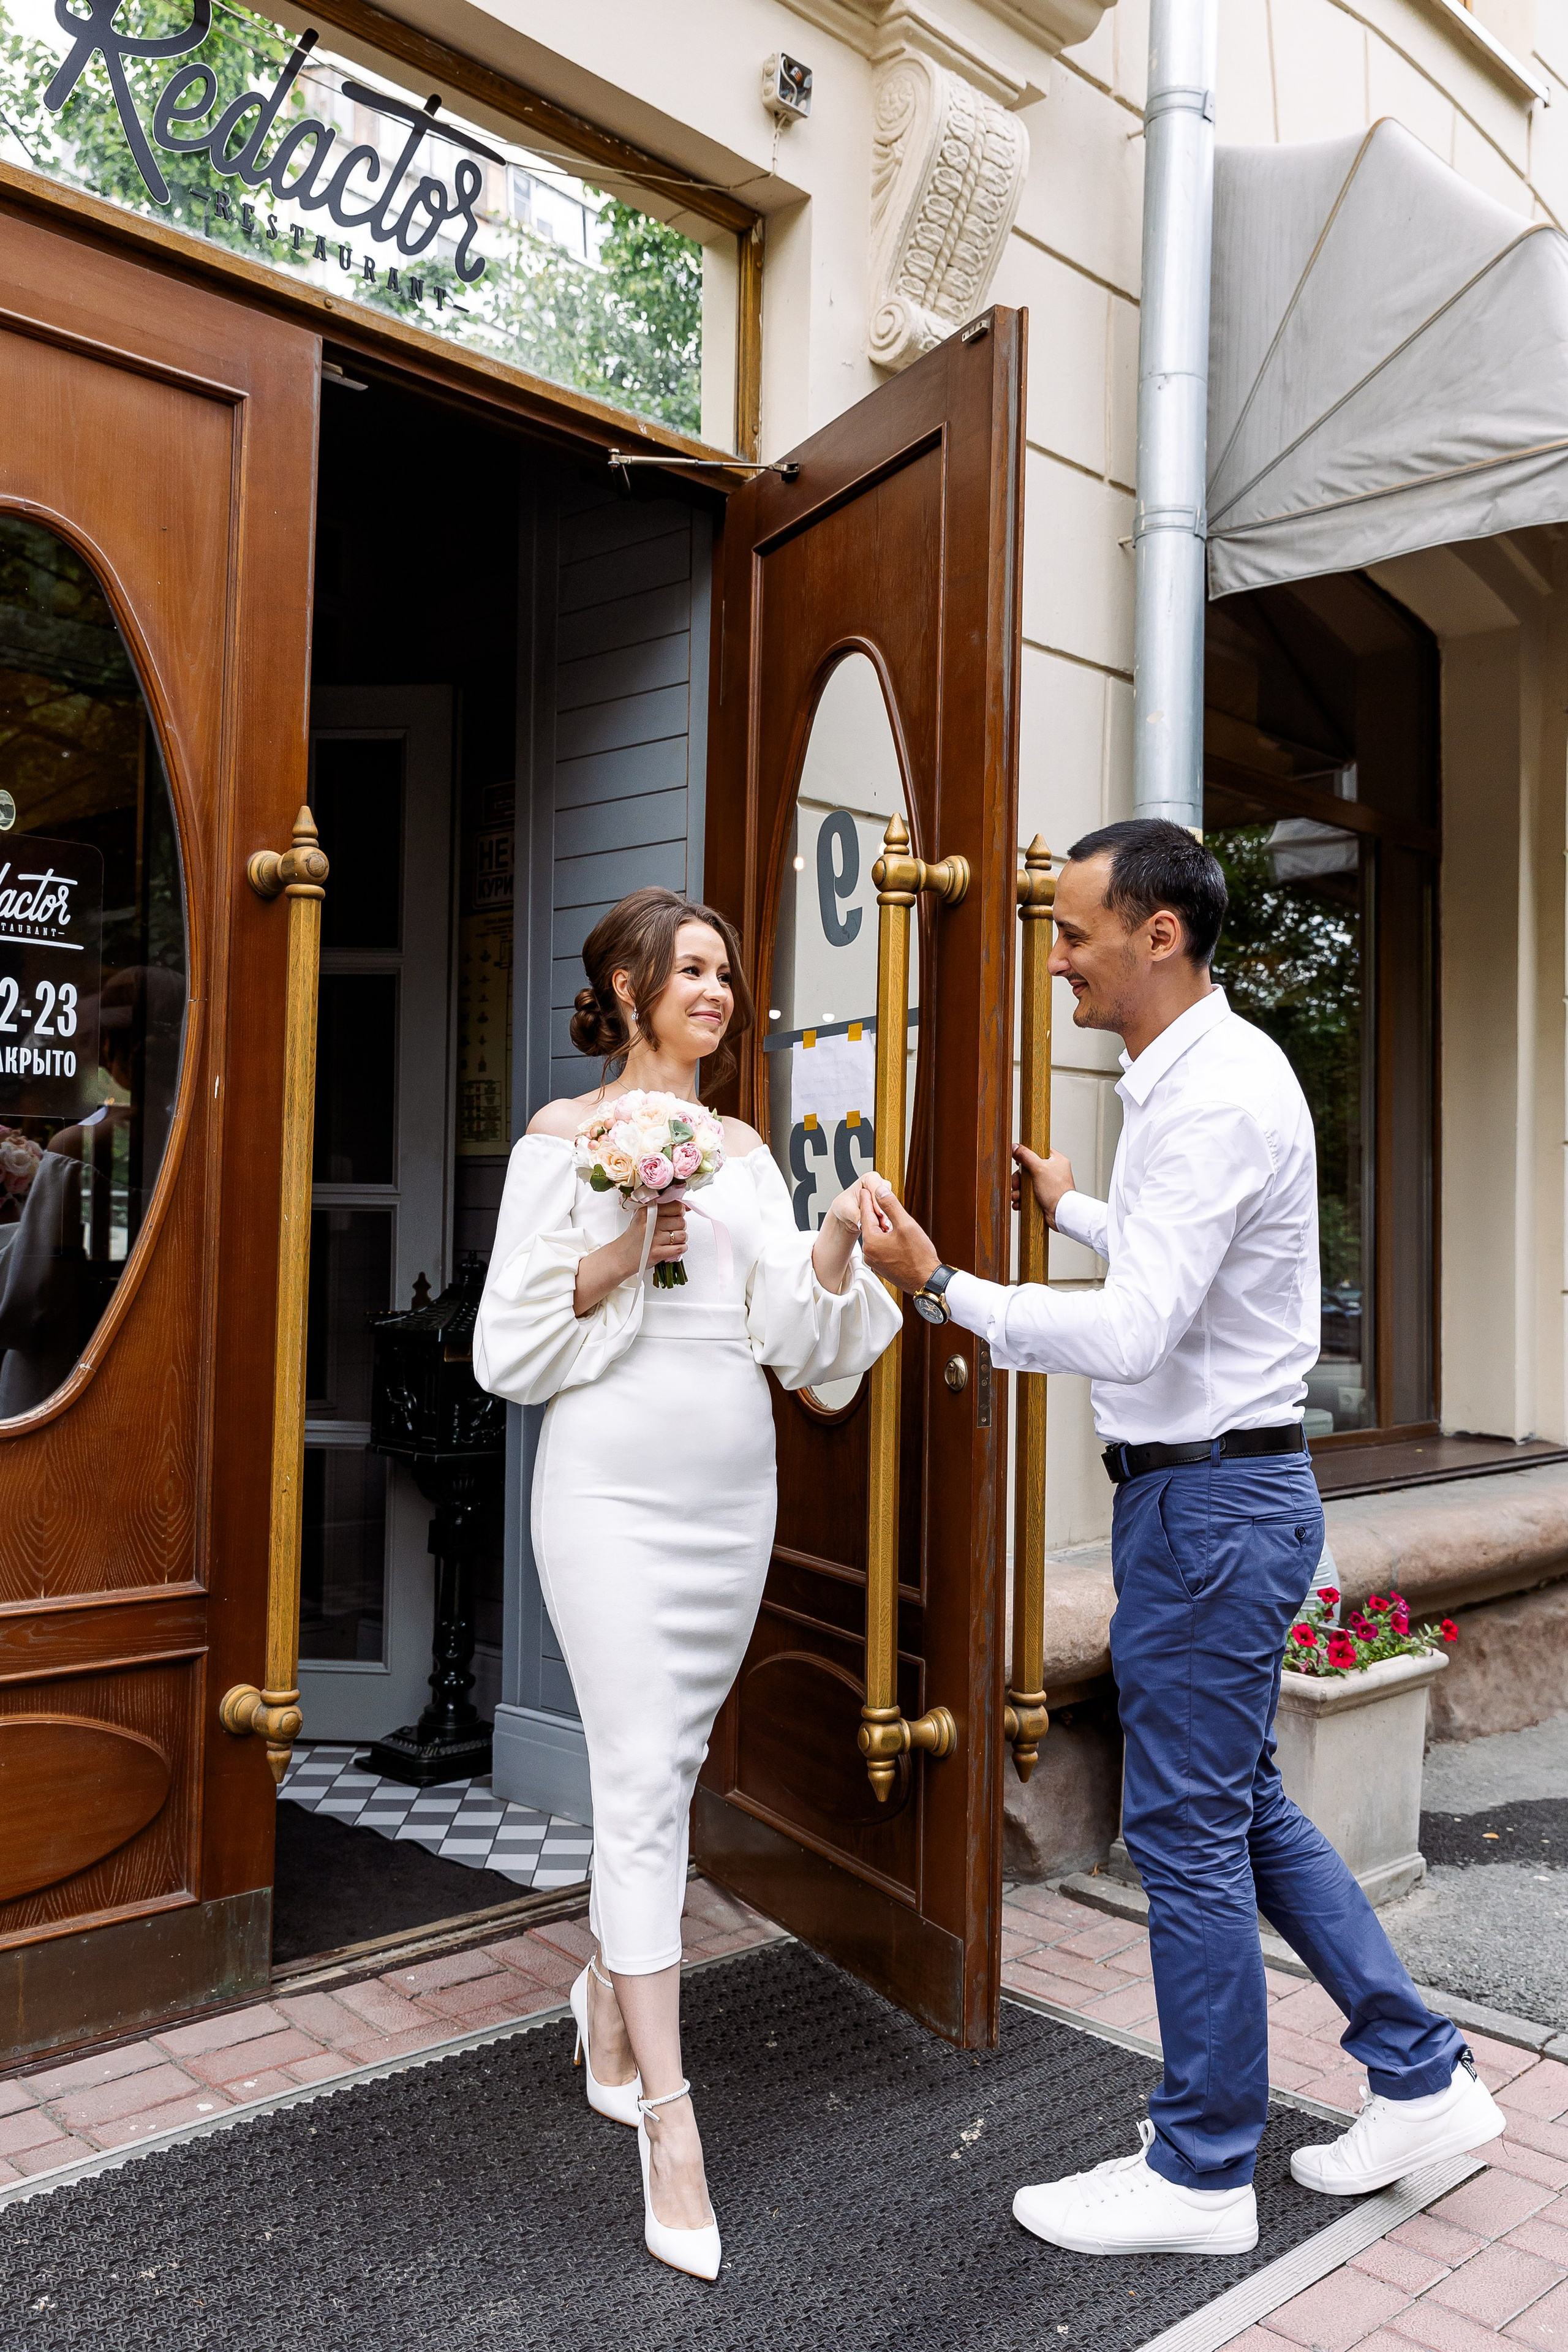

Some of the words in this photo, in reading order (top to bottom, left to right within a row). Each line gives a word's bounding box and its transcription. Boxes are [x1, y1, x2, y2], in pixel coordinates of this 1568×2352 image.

[43, 0, 507, 282] Redactor
[214, 191, 448, 311] RESTAURANT
[479, 837, 510, 871] НЕ
[0, 1046, 77, 1077] КРЫТО
